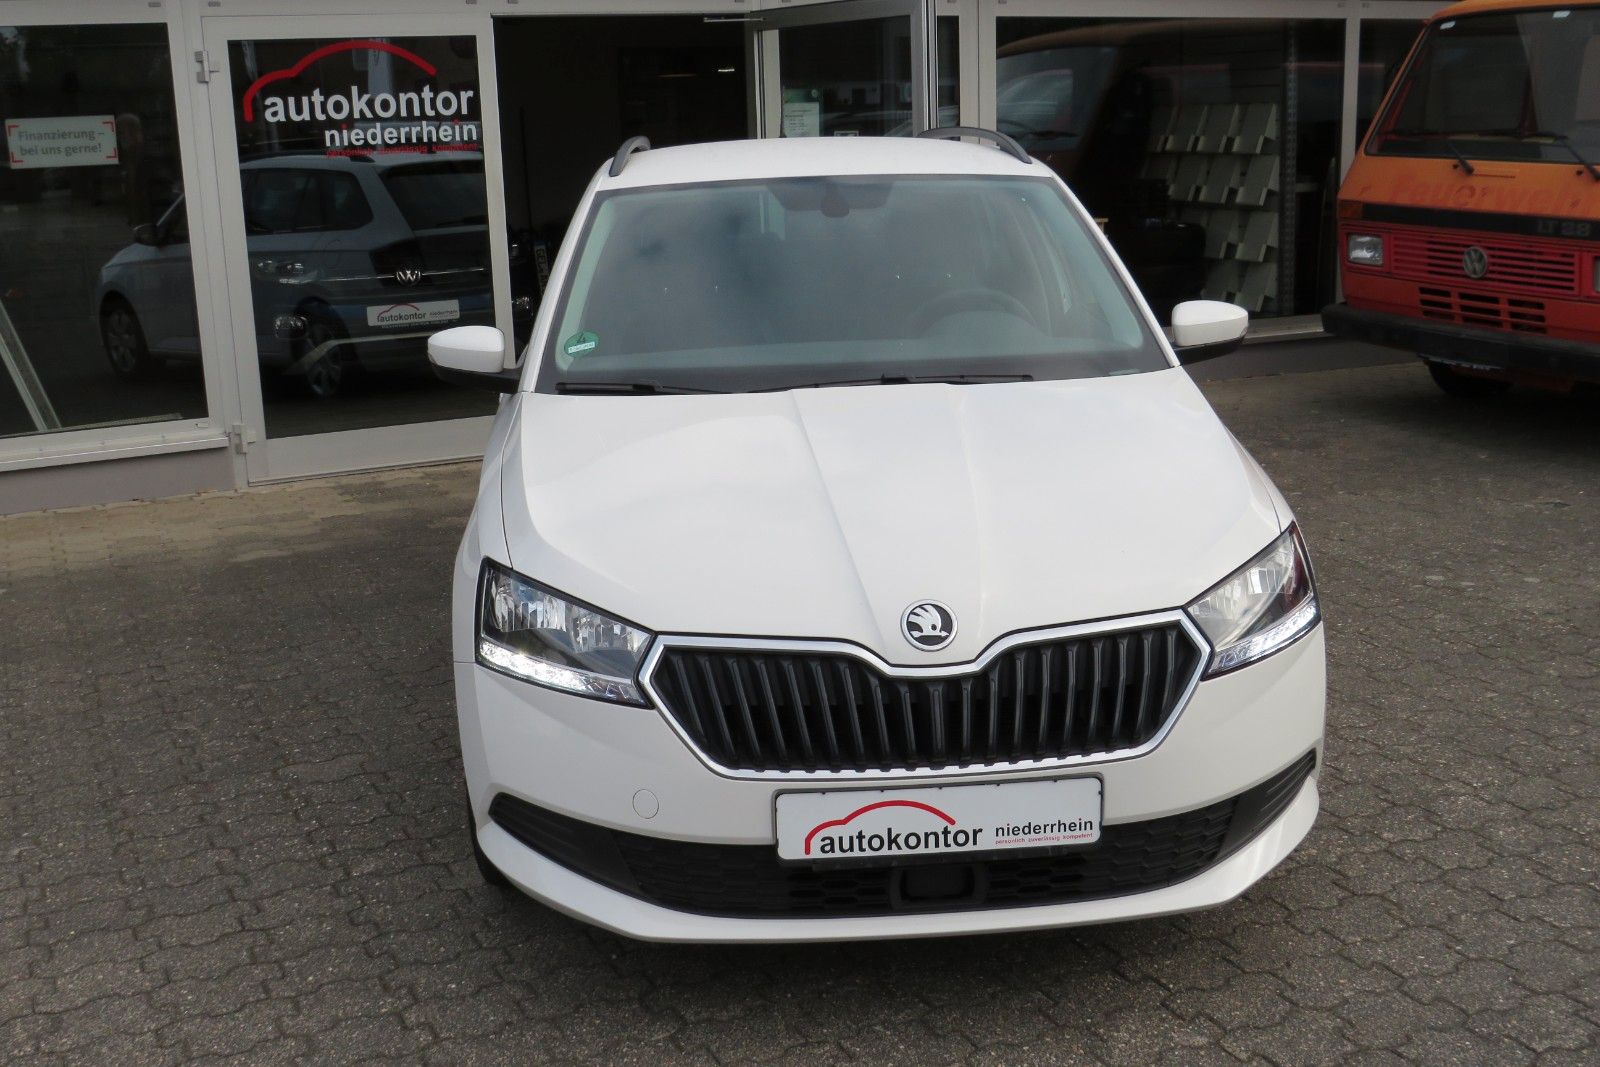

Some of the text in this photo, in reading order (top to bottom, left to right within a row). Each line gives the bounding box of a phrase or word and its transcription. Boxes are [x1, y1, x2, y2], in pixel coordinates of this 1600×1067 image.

[264, 84, 474, 123] autokontor
[18, 129, 96, 141] Finanzierung
[325, 119, 478, 147] niederrhein
[20, 143, 102, 157] bei uns gerne!
[379, 312, 427, 323] autokontor
[819, 818, 1093, 855] autokontor niederrhein
